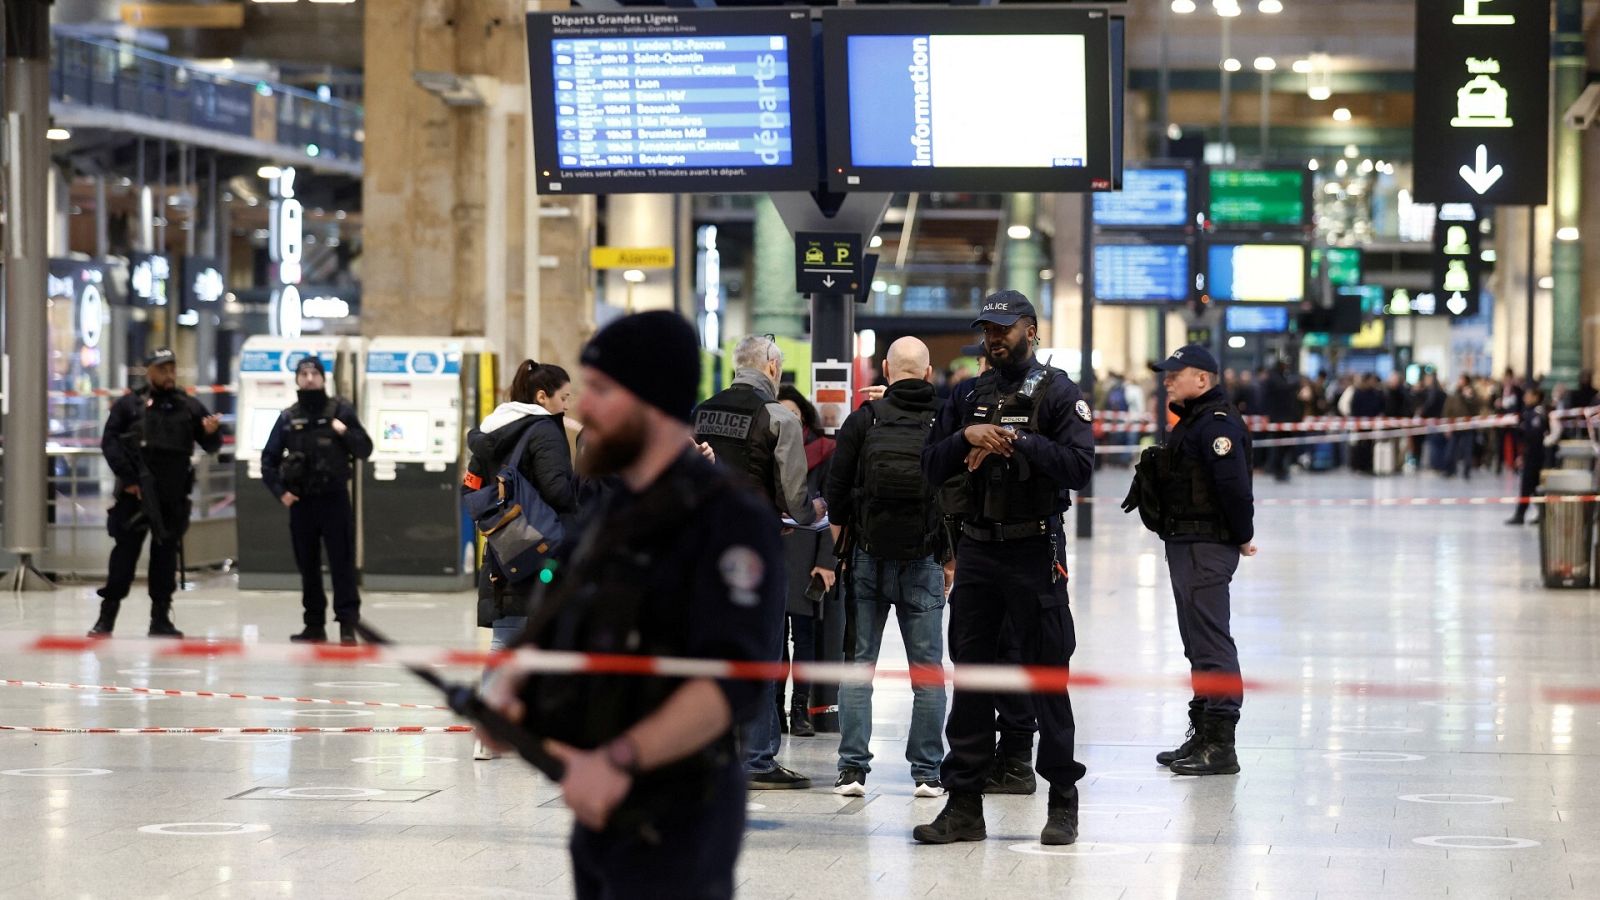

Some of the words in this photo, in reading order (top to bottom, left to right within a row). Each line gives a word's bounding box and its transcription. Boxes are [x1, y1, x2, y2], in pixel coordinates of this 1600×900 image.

[551, 15, 595, 26] Départs
[597, 14, 641, 25] Grandes
[643, 14, 679, 25] Lignes
[633, 41, 670, 50] London
[672, 40, 726, 50] St-Pancras
[634, 53, 704, 64] Saint-Quentin
[634, 66, 692, 76] Amsterdam
[693, 65, 737, 75] Centraal
[635, 79, 660, 89] Laon
[908, 37, 931, 167] information
[637, 103, 680, 114] Beauvais
[753, 53, 785, 165] départs
[638, 129, 683, 139] Bruxelles
[684, 128, 707, 138] Midi
[638, 142, 696, 152] Amsterdam
[697, 141, 740, 151] Centraal
[639, 154, 686, 166] Boulogne
[561, 170, 574, 178] Les
[595, 170, 611, 178] sont
[613, 169, 646, 177] affichées
[647, 169, 656, 177] 15
[658, 169, 688, 177] minutes
[711, 168, 718, 176] le
[837, 248, 850, 262] P
[983, 302, 1009, 312] POLICE
[699, 411, 749, 429] POLICE
[697, 424, 745, 438] JUDICIAIRE
